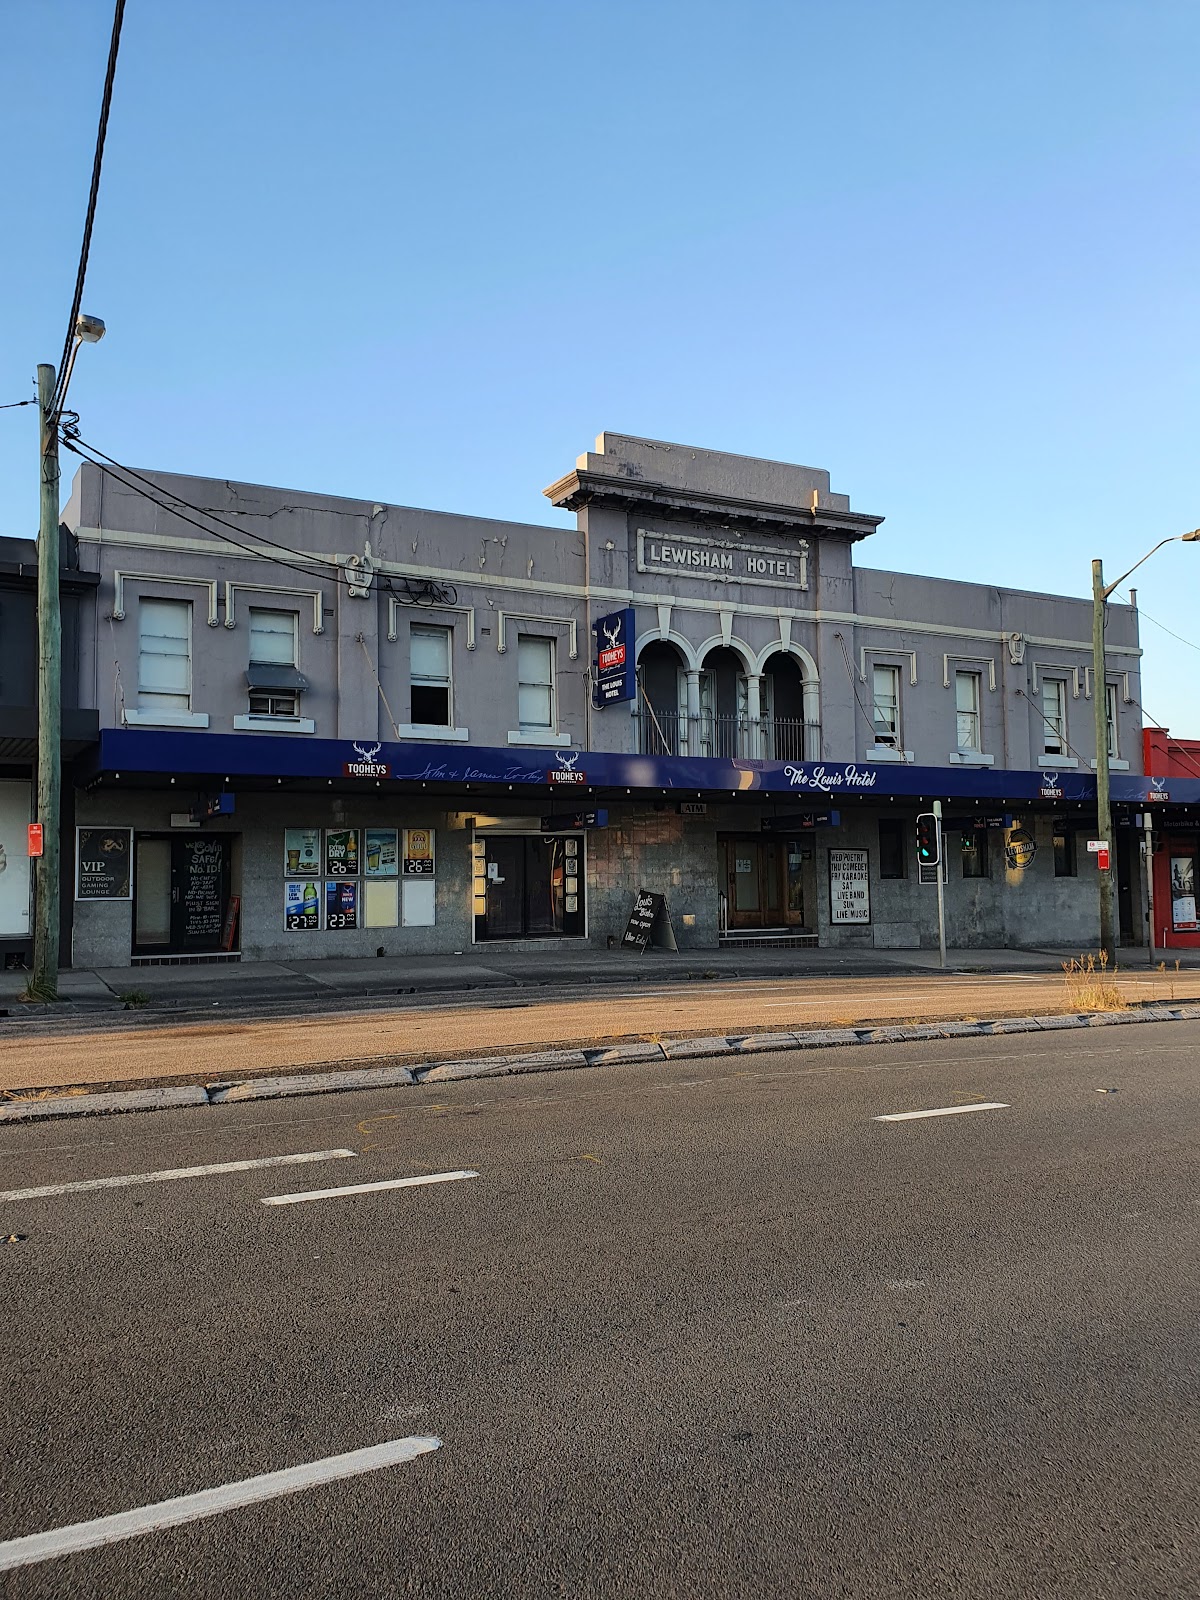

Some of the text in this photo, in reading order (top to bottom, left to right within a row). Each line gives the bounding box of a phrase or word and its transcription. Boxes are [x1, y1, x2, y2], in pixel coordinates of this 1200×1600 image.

[650, 544, 795, 577] LEWISHAM HOTEL
[602, 648, 624, 664] TOOHEYS
[605, 690, 619, 698] HOTEL
[348, 764, 387, 774] TOOHEYS
[551, 771, 584, 781] TOOHEYS
[784, 764, 876, 791] The Louis Hotel
[1041, 788, 1062, 796] TOOHEYS
[1150, 792, 1169, 800] TOOHEYS
[1008, 843, 1034, 855] LEWISHAM
[82, 862, 106, 871] VIP
[831, 863, 841, 871] THU
[842, 882, 853, 890] SAT
[634, 894, 653, 911] Louis
[836, 910, 848, 919] LIVE
